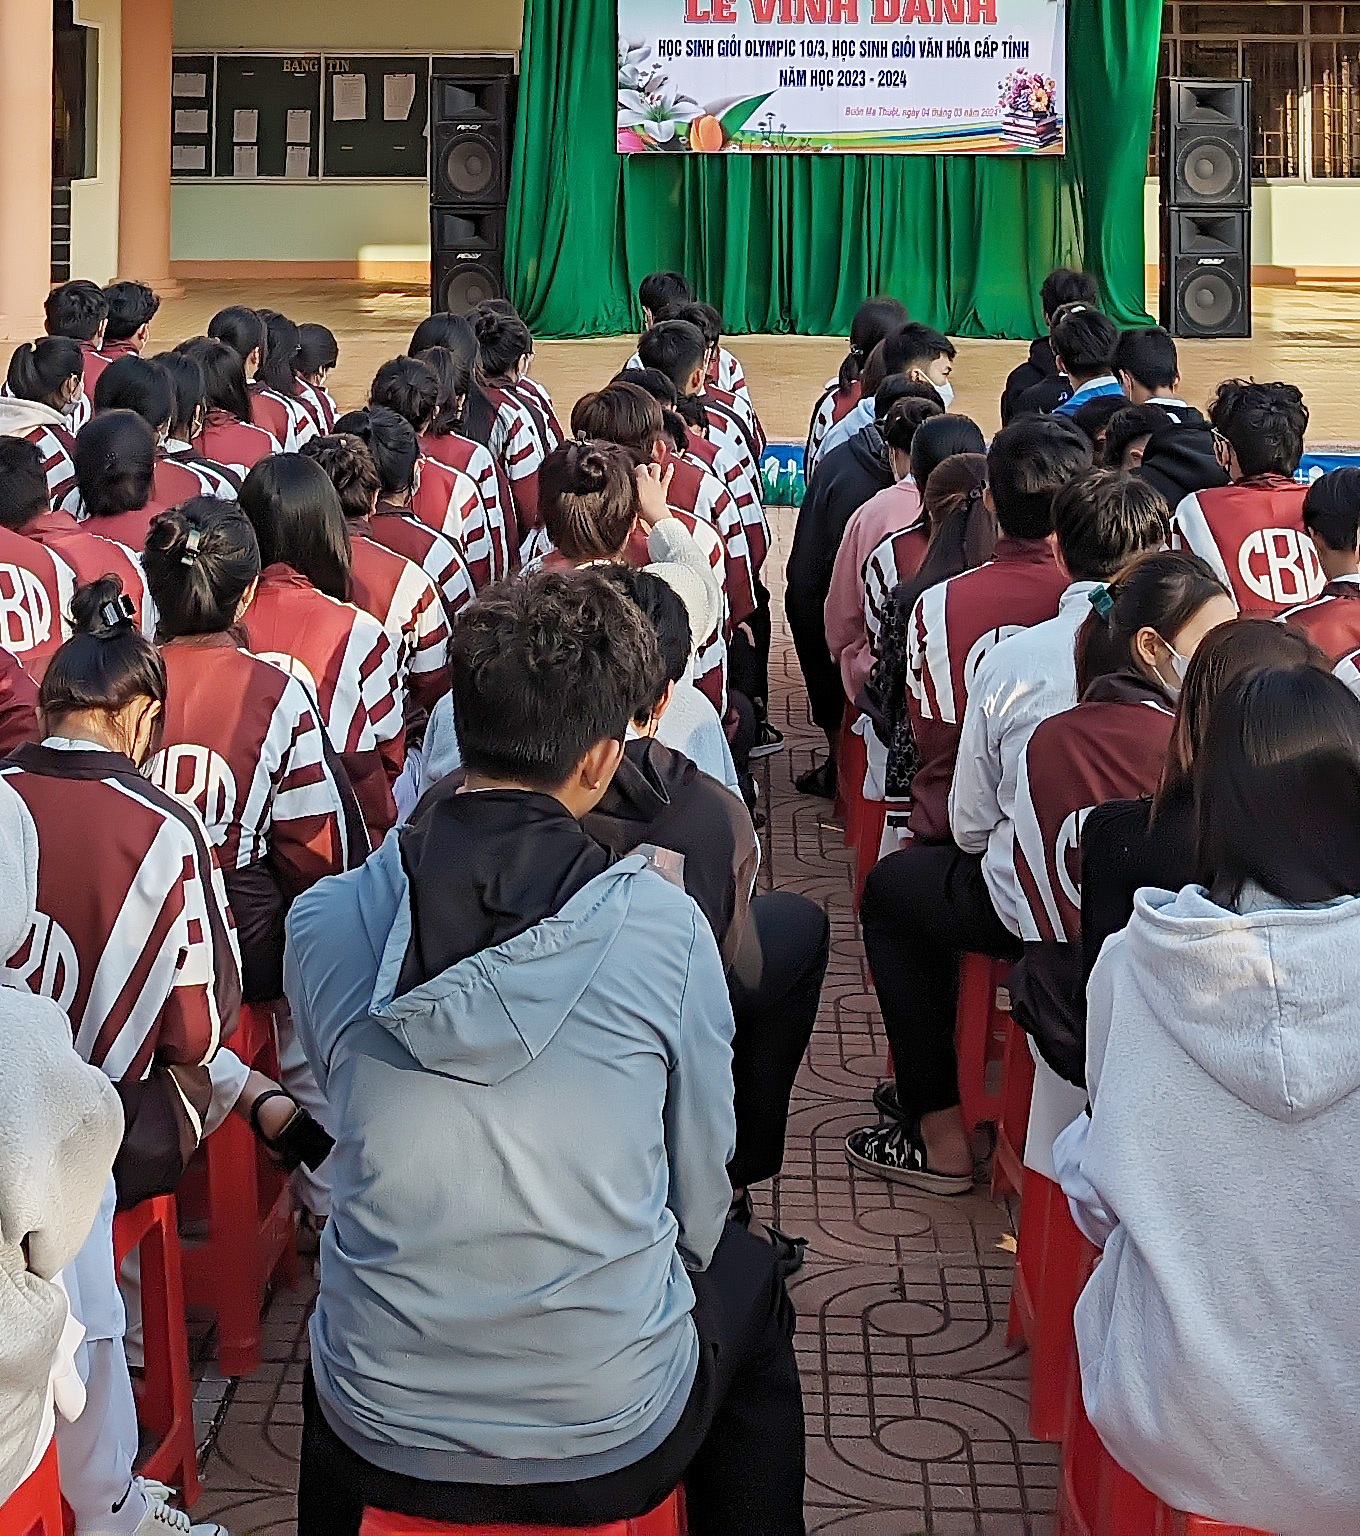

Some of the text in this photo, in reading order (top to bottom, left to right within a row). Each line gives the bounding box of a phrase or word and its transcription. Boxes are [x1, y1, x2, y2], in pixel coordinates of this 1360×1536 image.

[658, 39, 682, 62] HỌC
[686, 39, 714, 58] SINH
[717, 33, 741, 58] GIỎI
[745, 39, 796, 58] OLYMPIC
[800, 39, 829, 60] 10/3,
[832, 39, 856, 62] HỌC
[860, 39, 888, 58] SINH
[891, 34, 916, 58] GIỎI
[919, 37, 943, 58] VĂN
[946, 37, 971, 58] HÓA
[974, 35, 999, 58] CẤP
[327, 59, 351, 72] TIN
[779, 66, 807, 87] NĂM
[810, 69, 834, 91] HỌC
[837, 69, 866, 87] 2023
[877, 69, 907, 88] 2024
